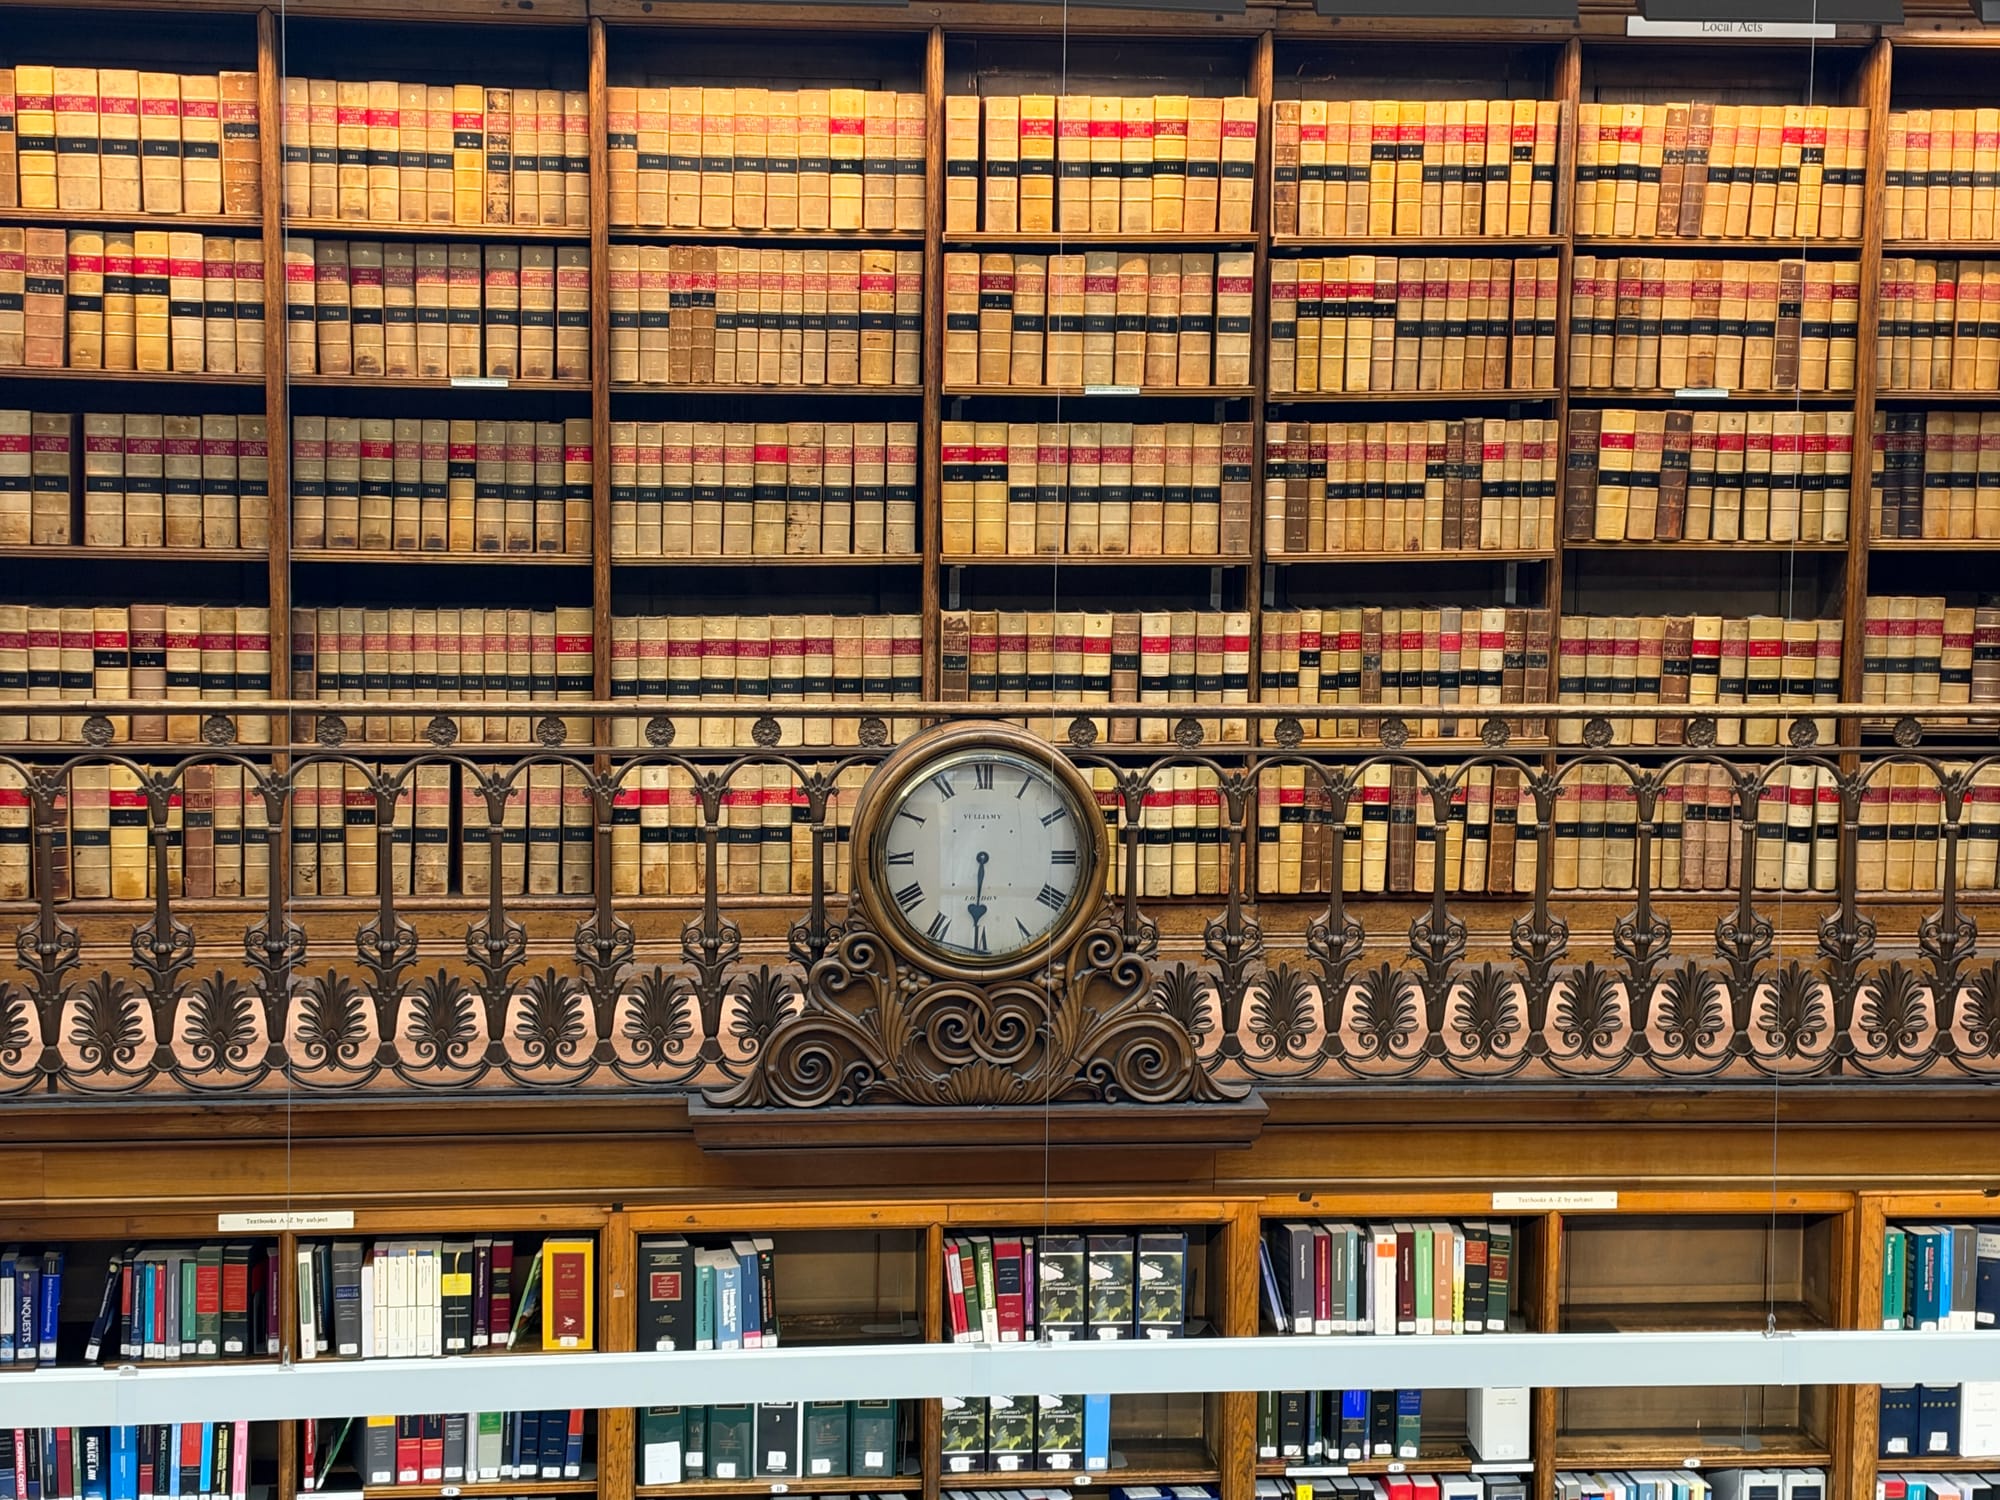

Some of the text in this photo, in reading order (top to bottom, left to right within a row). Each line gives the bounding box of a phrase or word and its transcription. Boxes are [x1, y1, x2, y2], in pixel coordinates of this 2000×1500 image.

[1701, 21, 1763, 33] Local Acts
[931, 774, 957, 802] XI
[974, 764, 994, 790] XII
[1015, 775, 1034, 799] I
[899, 806, 927, 829] X
[1040, 807, 1066, 828] II
[888, 850, 915, 865] IX
[1051, 850, 1076, 865] III
[896, 881, 926, 913] VIII
[1035, 883, 1066, 912] IIII
[926, 910, 952, 942] VII
[1015, 916, 1031, 938] V
[1573, 1196, 1593, 1204] subject
[246, 1217, 277, 1225] Textbooks
[296, 1216, 304, 1224] by
[306, 1216, 328, 1224] subject
[21, 1296, 32, 1343] INQUESTS
[86, 1436, 97, 1481] POLICE LAW
[17, 1473, 25, 1496] COSTS
